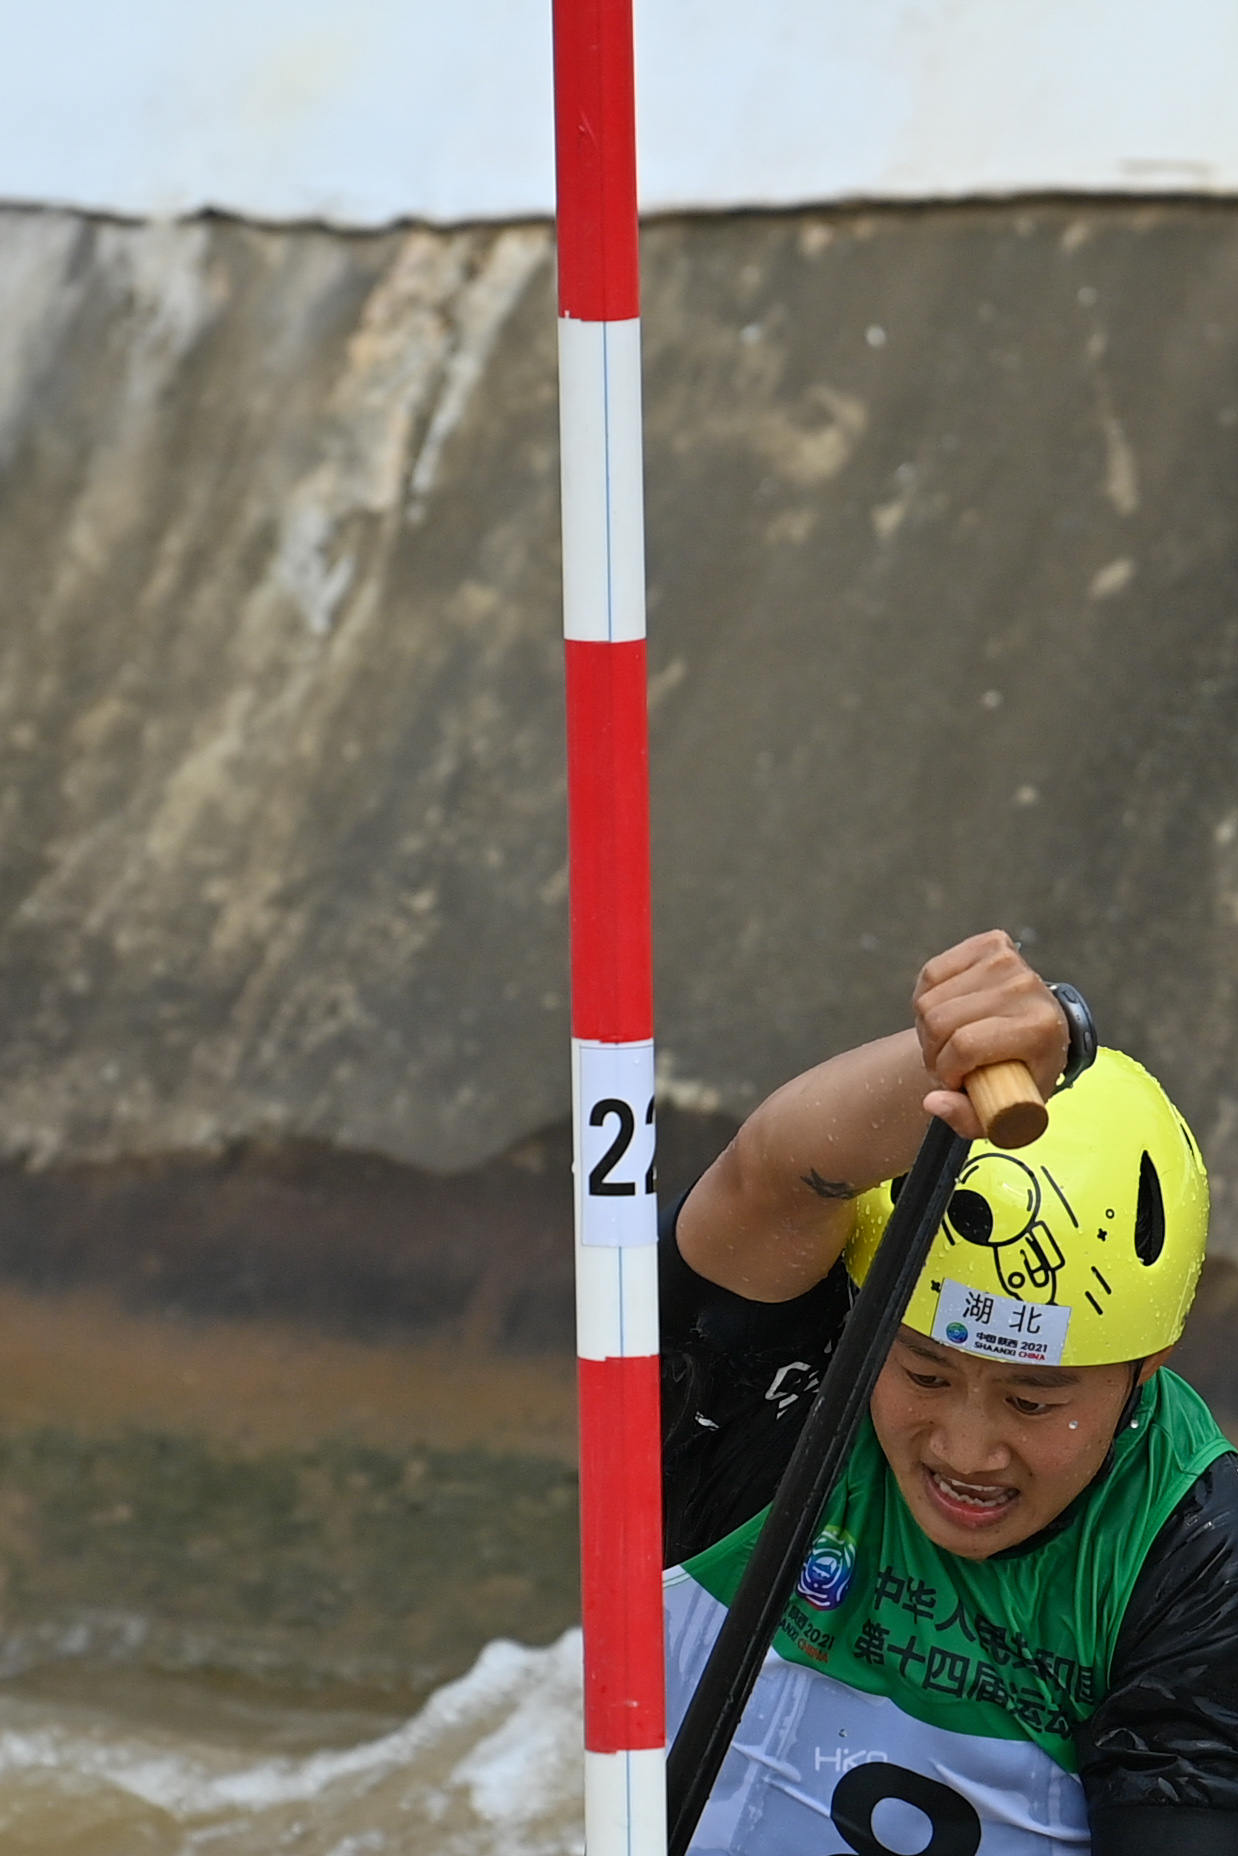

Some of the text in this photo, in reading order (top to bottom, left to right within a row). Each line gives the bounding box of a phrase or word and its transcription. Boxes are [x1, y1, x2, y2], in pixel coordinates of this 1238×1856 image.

[589, 1096, 657, 1196] 2
[962, 1291, 1042, 1334] 湖北
[974, 1342, 1045, 1361] SHAANXI CHINA
[1020, 1341, 1048, 1353] 2021
[804, 1623, 835, 1650] 2021
